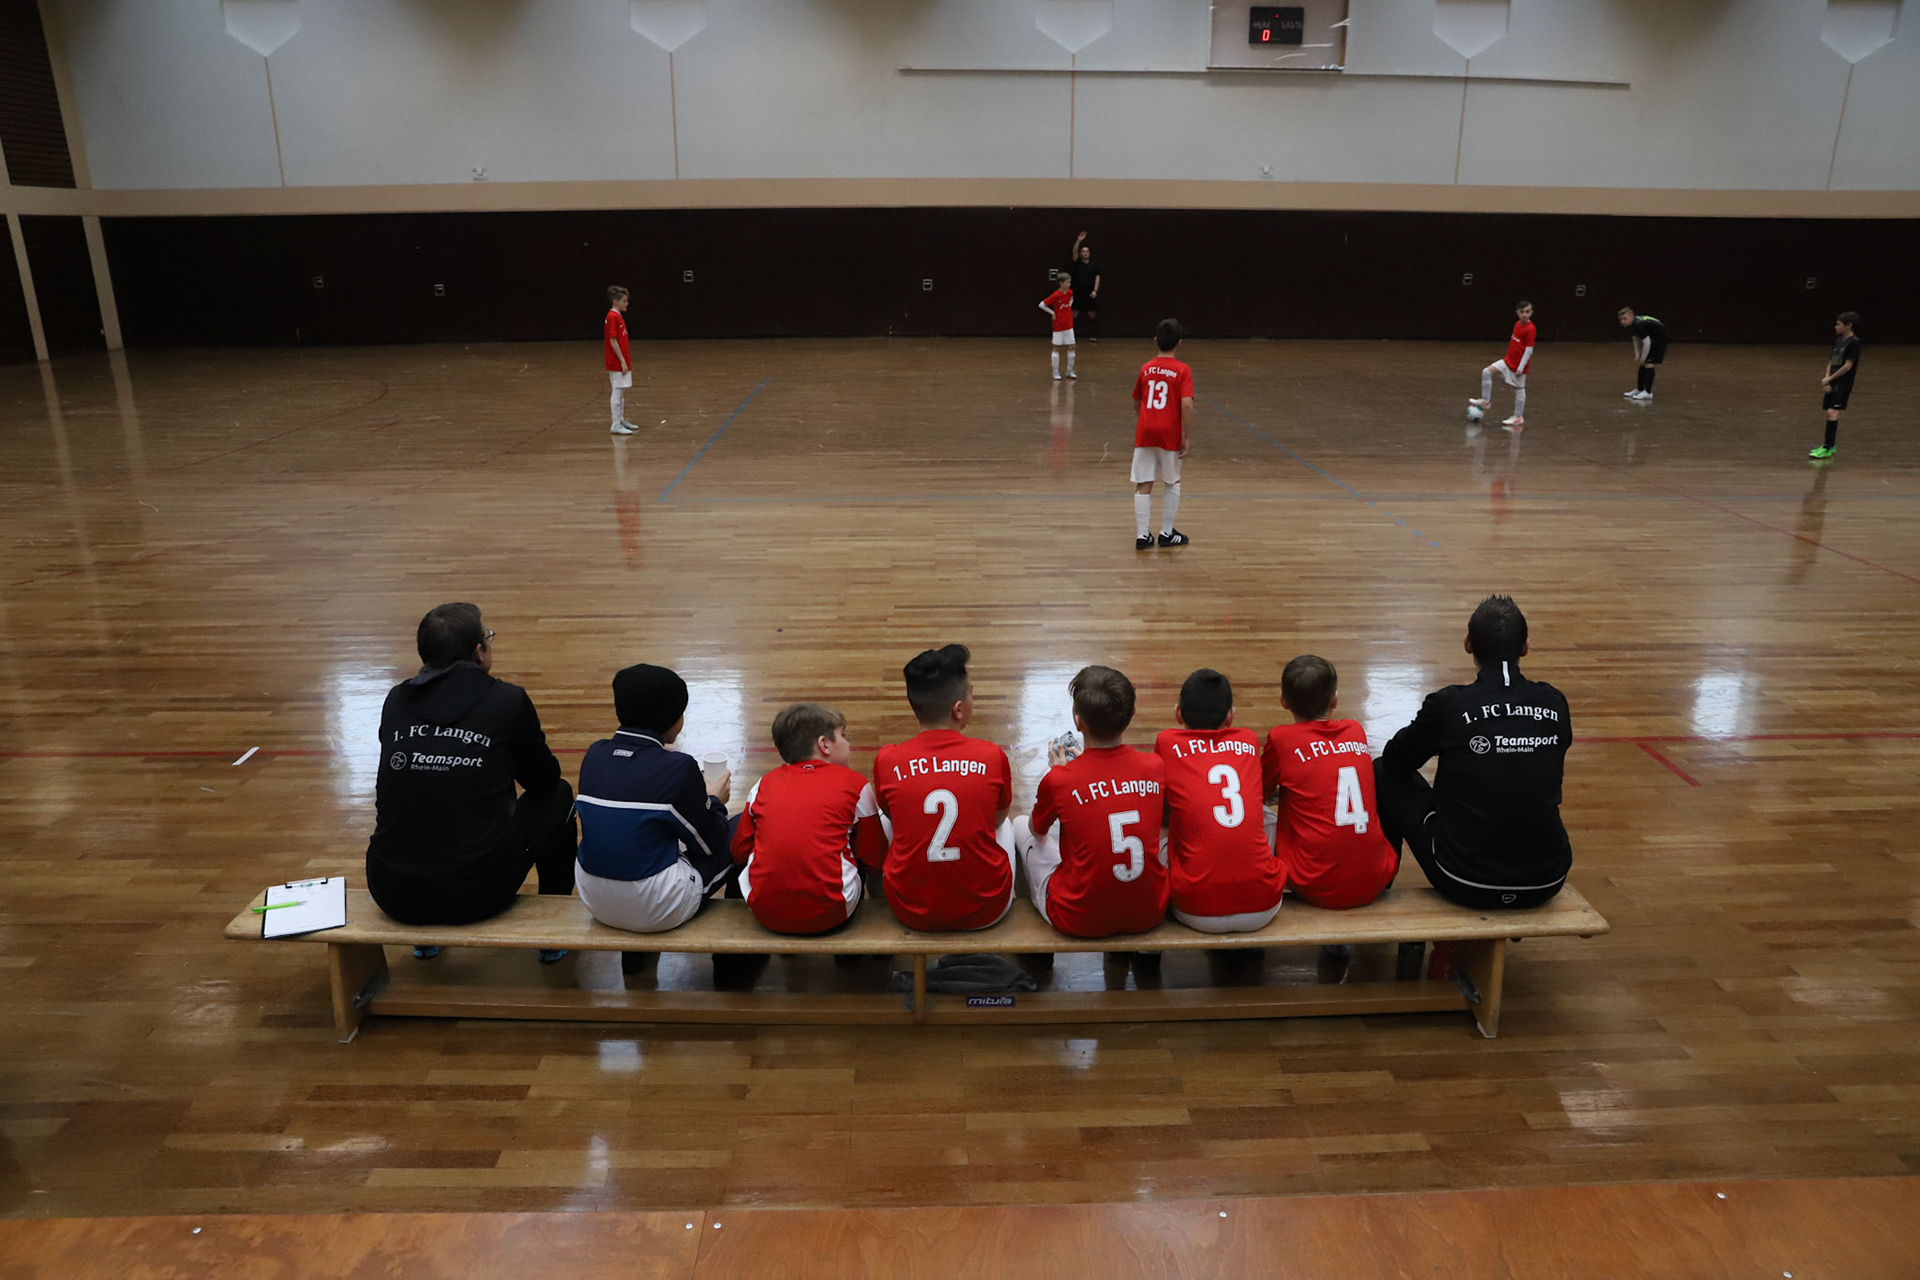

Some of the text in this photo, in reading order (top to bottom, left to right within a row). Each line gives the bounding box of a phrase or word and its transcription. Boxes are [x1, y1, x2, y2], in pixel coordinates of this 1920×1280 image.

[1261, 29, 1271, 42] 0
[1149, 366, 1156, 374] FC
[1157, 367, 1177, 378] Langen
[1146, 379, 1169, 410] 13
[1462, 703, 1559, 724] 1. FC Langen
[393, 724, 492, 748] 1. FC Langen
[1494, 735, 1559, 748] Teamsport
[1172, 739, 1256, 758] 1. FC Langen
[1294, 748, 1311, 762] 1.
[1310, 741, 1330, 757] FC
[410, 763, 450, 772] Rhein-Main
[411, 752, 483, 768] Teamsport
[893, 756, 986, 781] 1. FC Langen
[1071, 778, 1160, 805] 1. FC Langen
[1207, 763, 1245, 828] 3
[1334, 765, 1369, 835] 4
[923, 788, 961, 863] 2
[1108, 809, 1145, 882] 5
